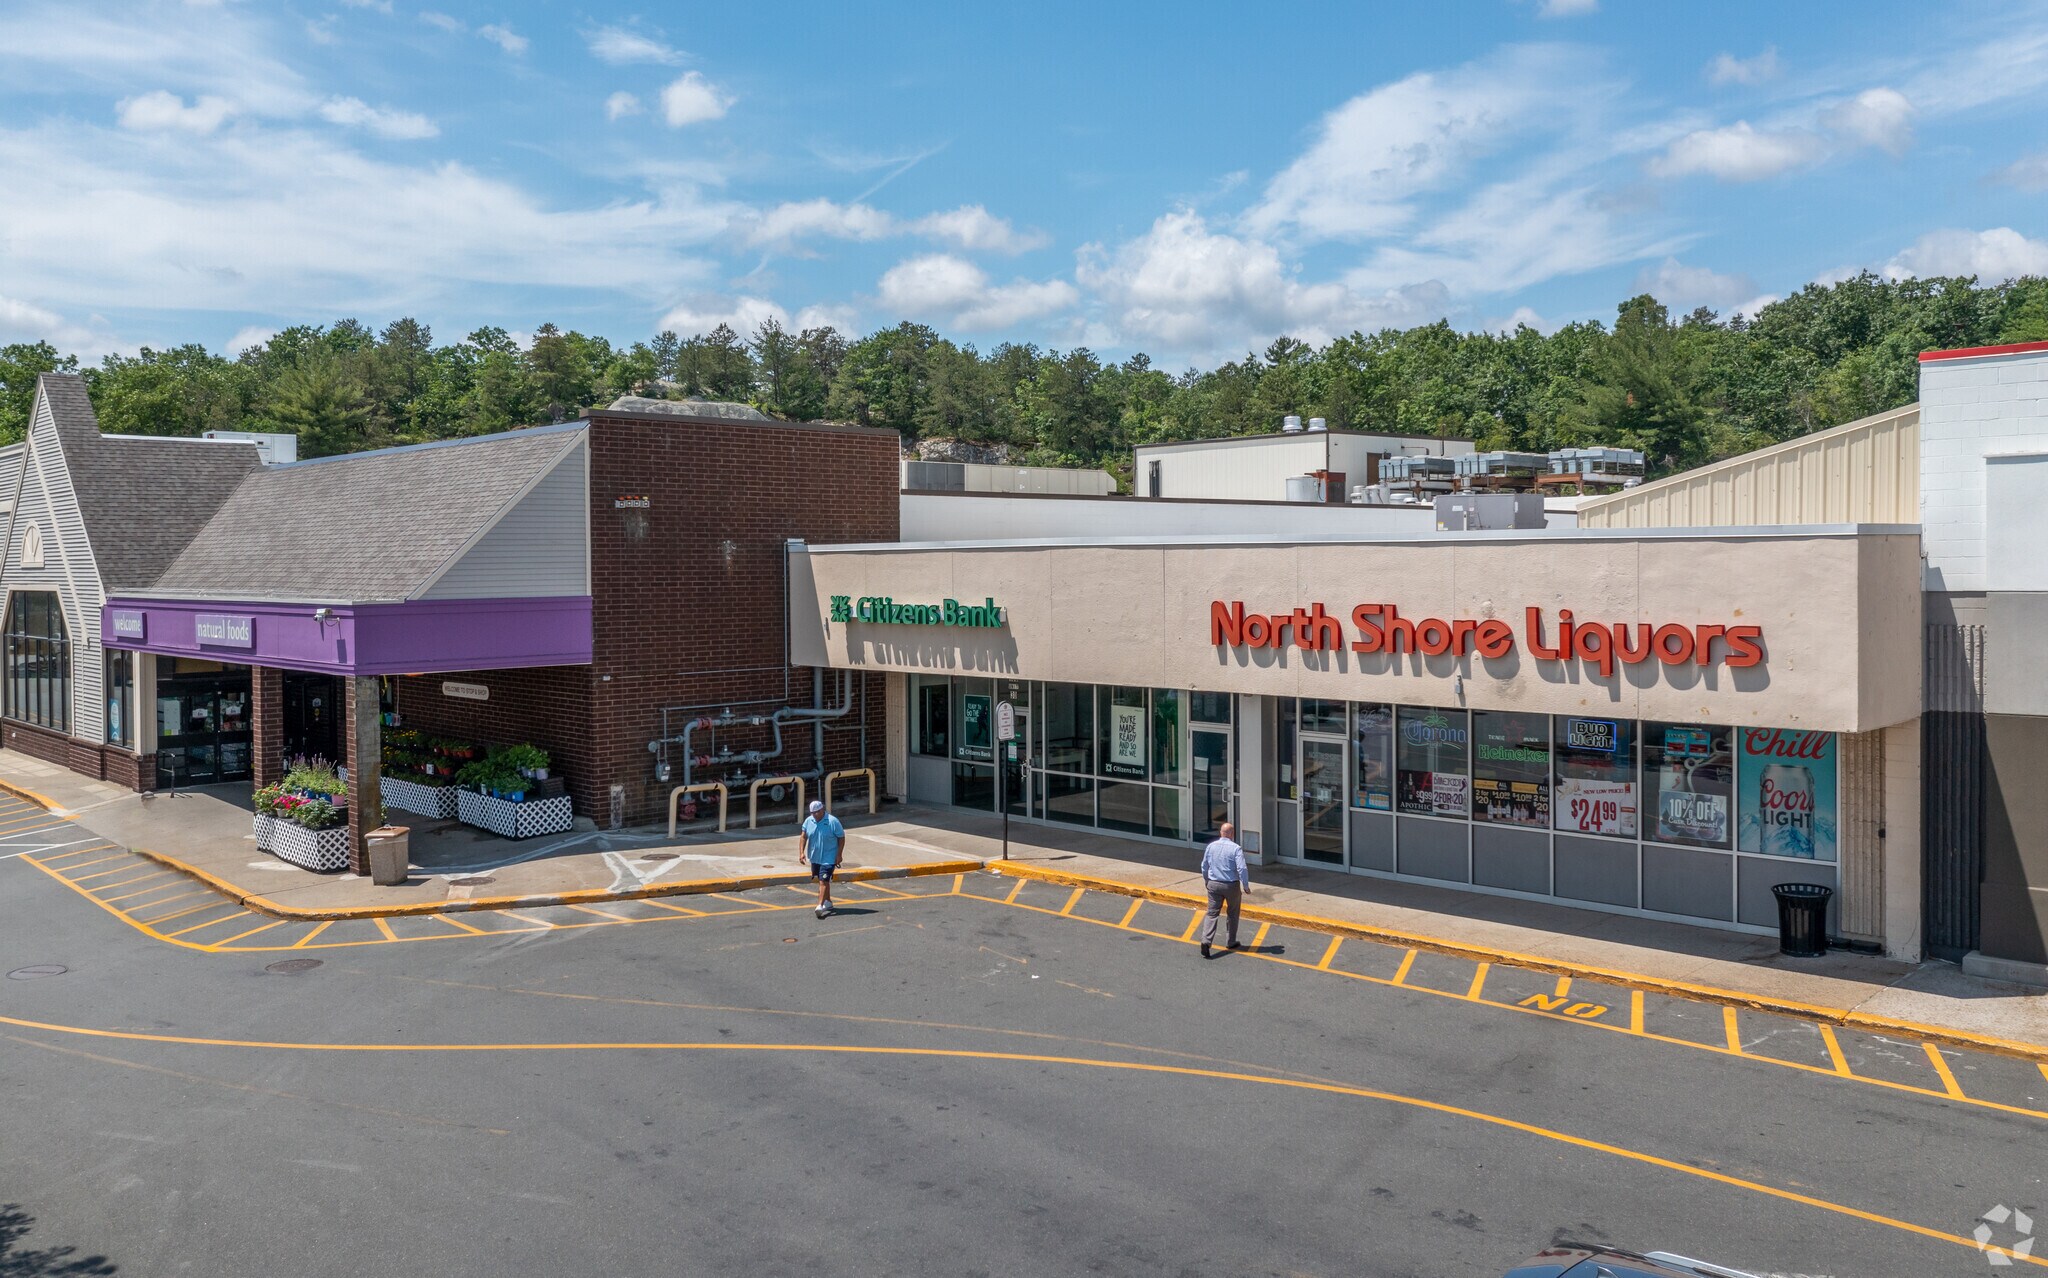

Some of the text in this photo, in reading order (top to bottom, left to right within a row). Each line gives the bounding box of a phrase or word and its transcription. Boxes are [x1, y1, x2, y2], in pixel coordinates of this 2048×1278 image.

[856, 596, 1002, 628] Citizens Bank
[114, 614, 141, 632] welcome
[197, 619, 250, 641] natural foods
[1210, 600, 1763, 677] North Shore Liquors
[1119, 724, 1136, 734] MADE
[1119, 733, 1137, 743] READY
[1404, 720, 1467, 743] Corona
[1575, 722, 1608, 736] BUD
[1569, 733, 1613, 748] LIGHT
[1744, 726, 1832, 759] Chill
[965, 749, 981, 757] Citizens
[1112, 765, 1145, 775] Citizens Bank
[1760, 779, 1814, 812] Coors
[1400, 801, 1432, 811] APOTHIC
[1669, 798, 1717, 821] 10% OFF
[1686, 817, 1718, 828] Discount!
[1763, 809, 1812, 828] LIGHT
[1517, 993, 1608, 1018] NO
